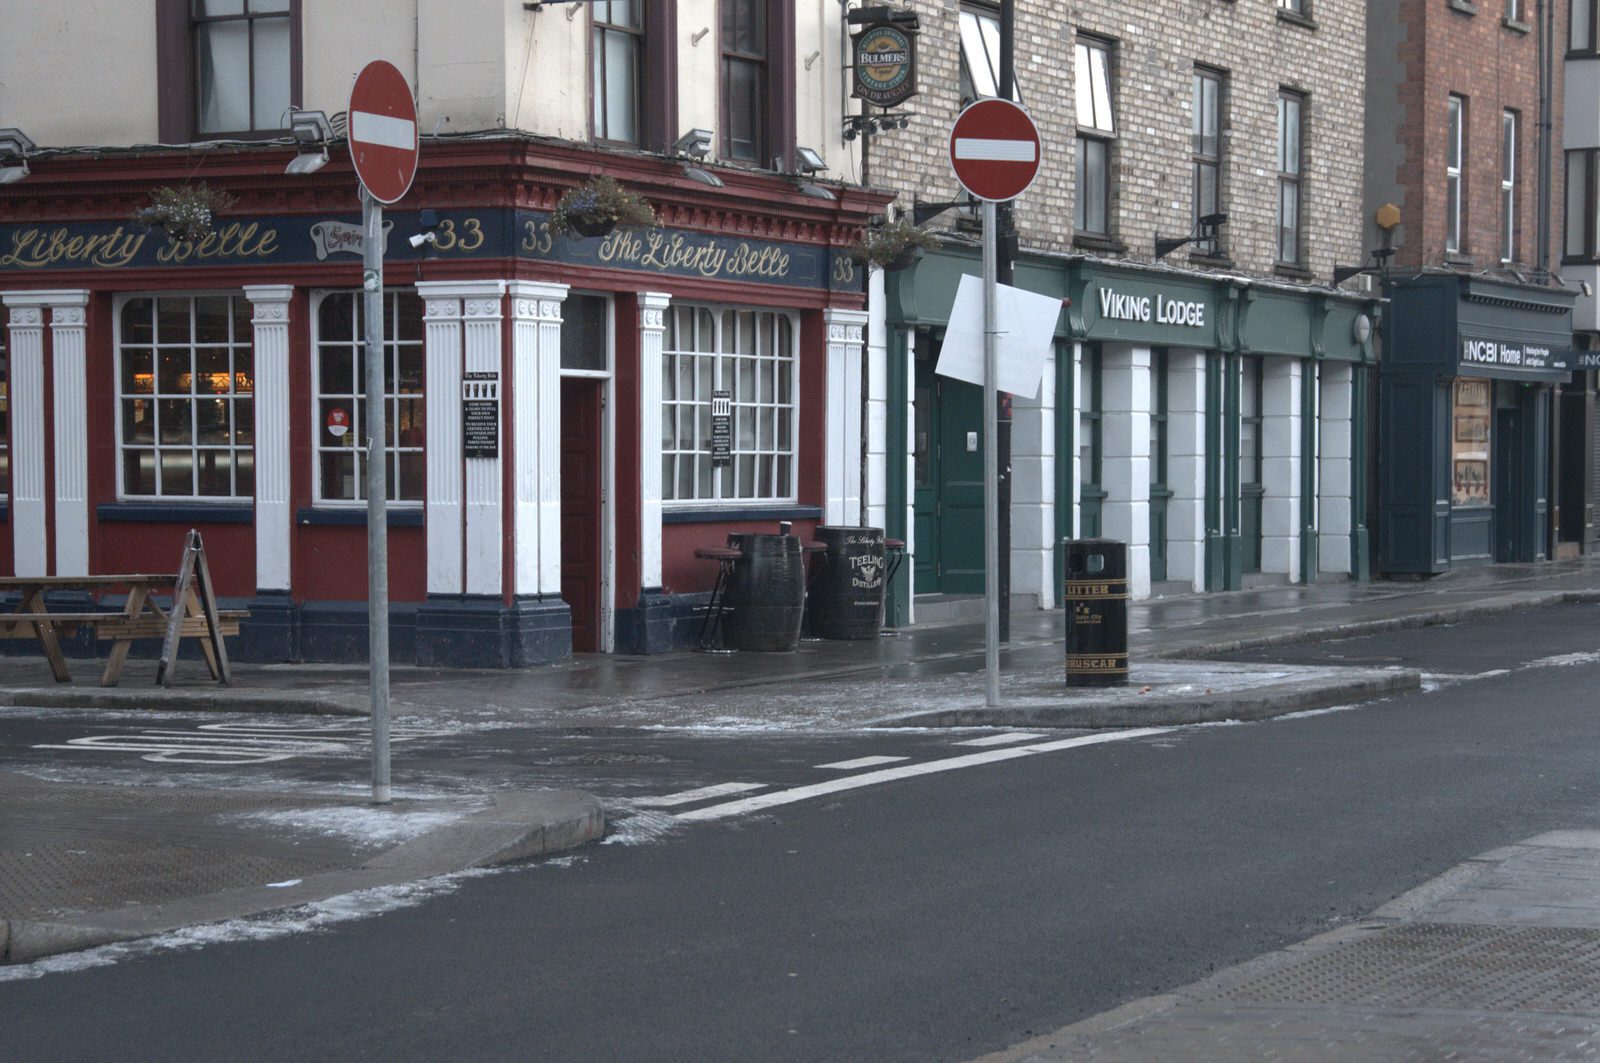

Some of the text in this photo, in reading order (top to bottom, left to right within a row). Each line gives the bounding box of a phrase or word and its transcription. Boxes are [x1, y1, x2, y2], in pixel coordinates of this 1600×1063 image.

[861, 52, 906, 64] BULMERS
[1, 226, 146, 267] Liberty
[433, 218, 484, 250] 33
[522, 220, 552, 253] 33
[598, 229, 790, 277] The Liberty Belle
[833, 256, 854, 282] 33
[1100, 287, 1205, 326] VIKING LODGE
[1468, 340, 1498, 363] NCBI
[1500, 343, 1521, 365] Home
[849, 554, 884, 569] TEELING
[1067, 584, 1109, 595] LITTER
